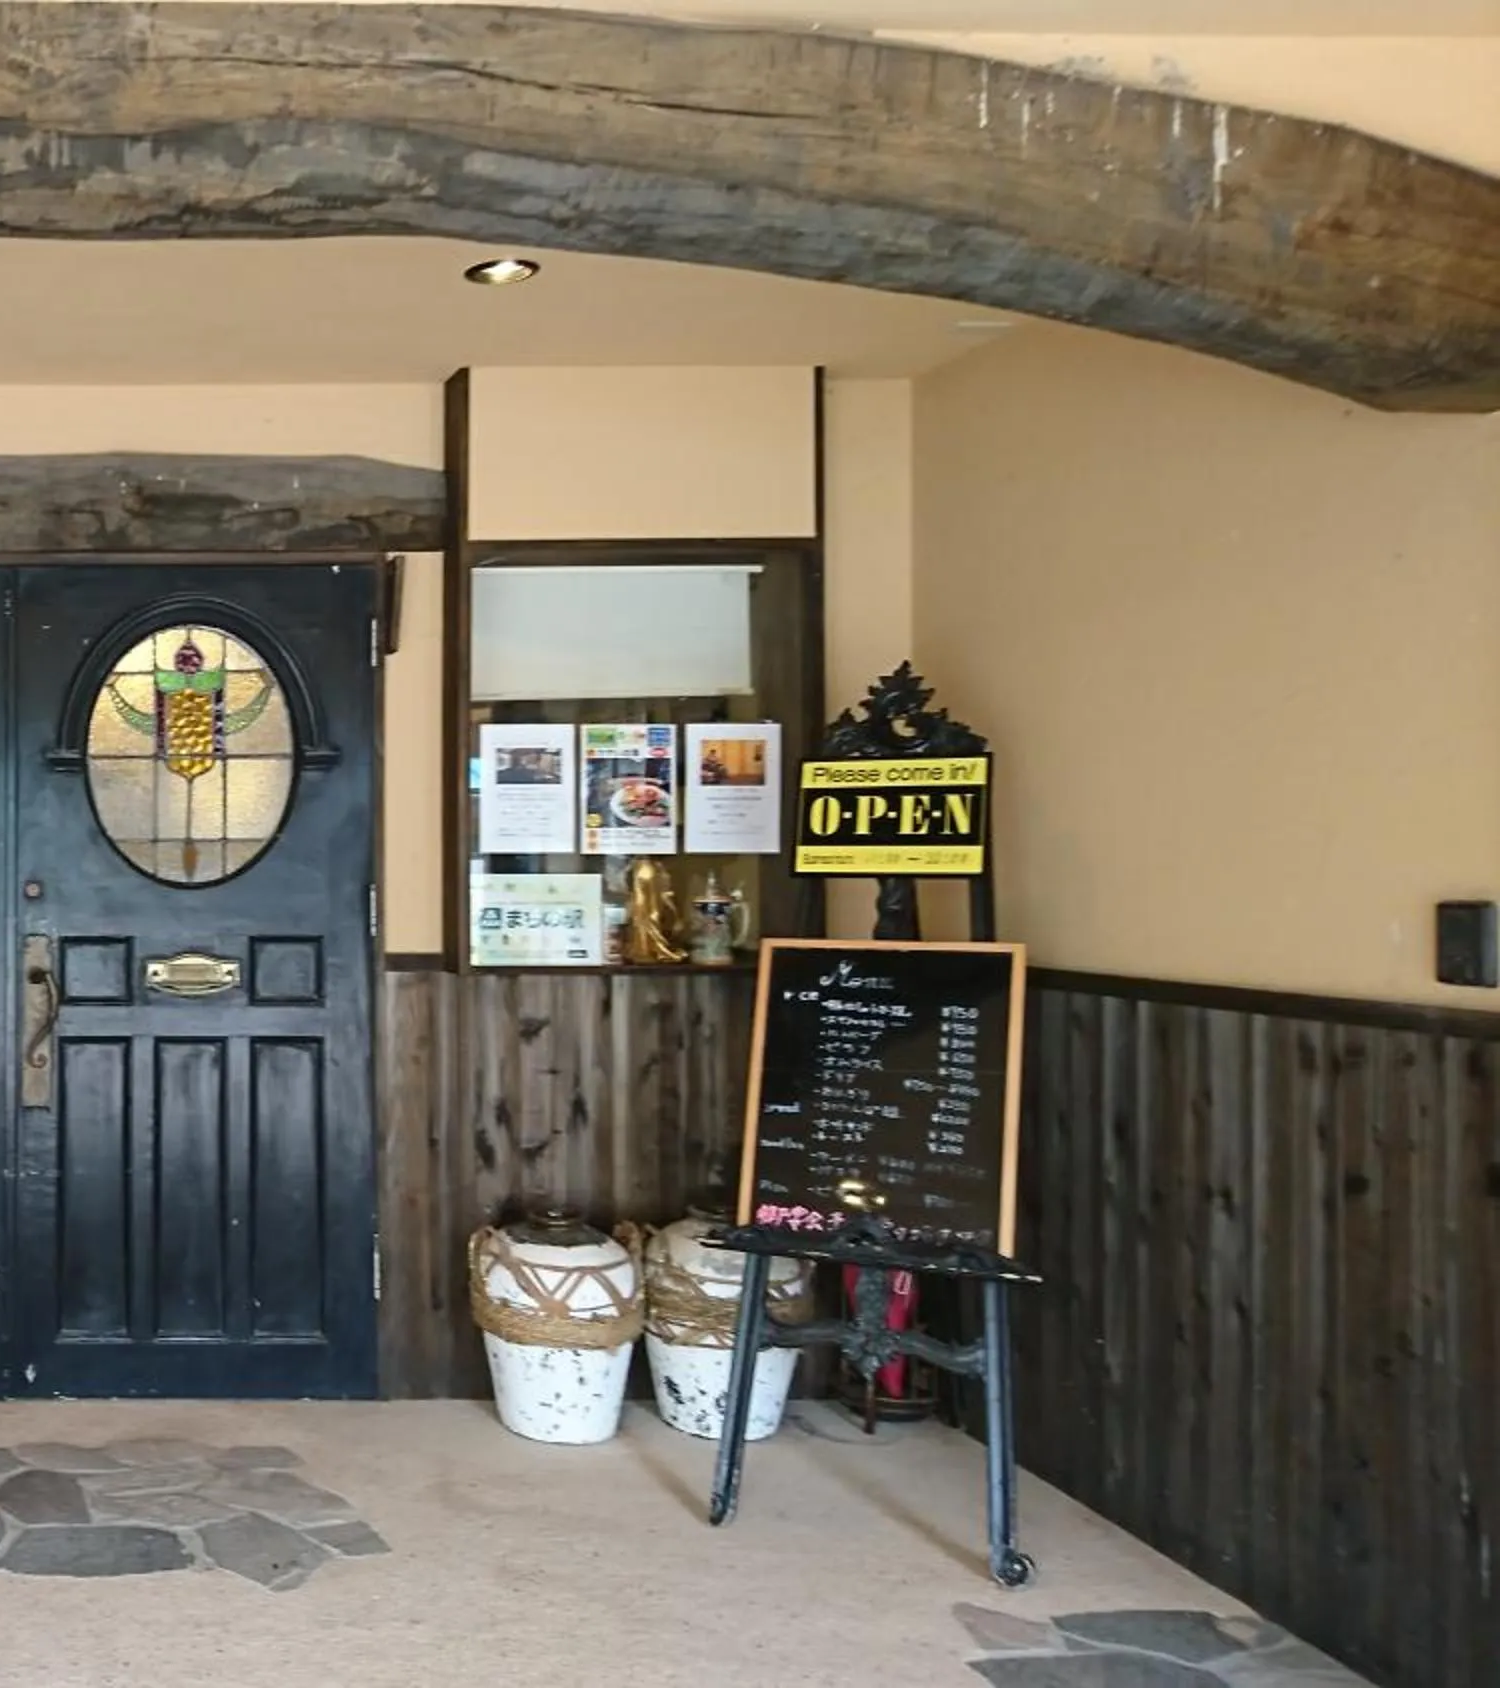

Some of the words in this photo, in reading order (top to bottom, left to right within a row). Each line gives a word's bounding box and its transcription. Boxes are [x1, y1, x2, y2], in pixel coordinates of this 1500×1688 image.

[811, 767, 881, 783] Please
[886, 767, 943, 782] come
[949, 763, 978, 780] in!
